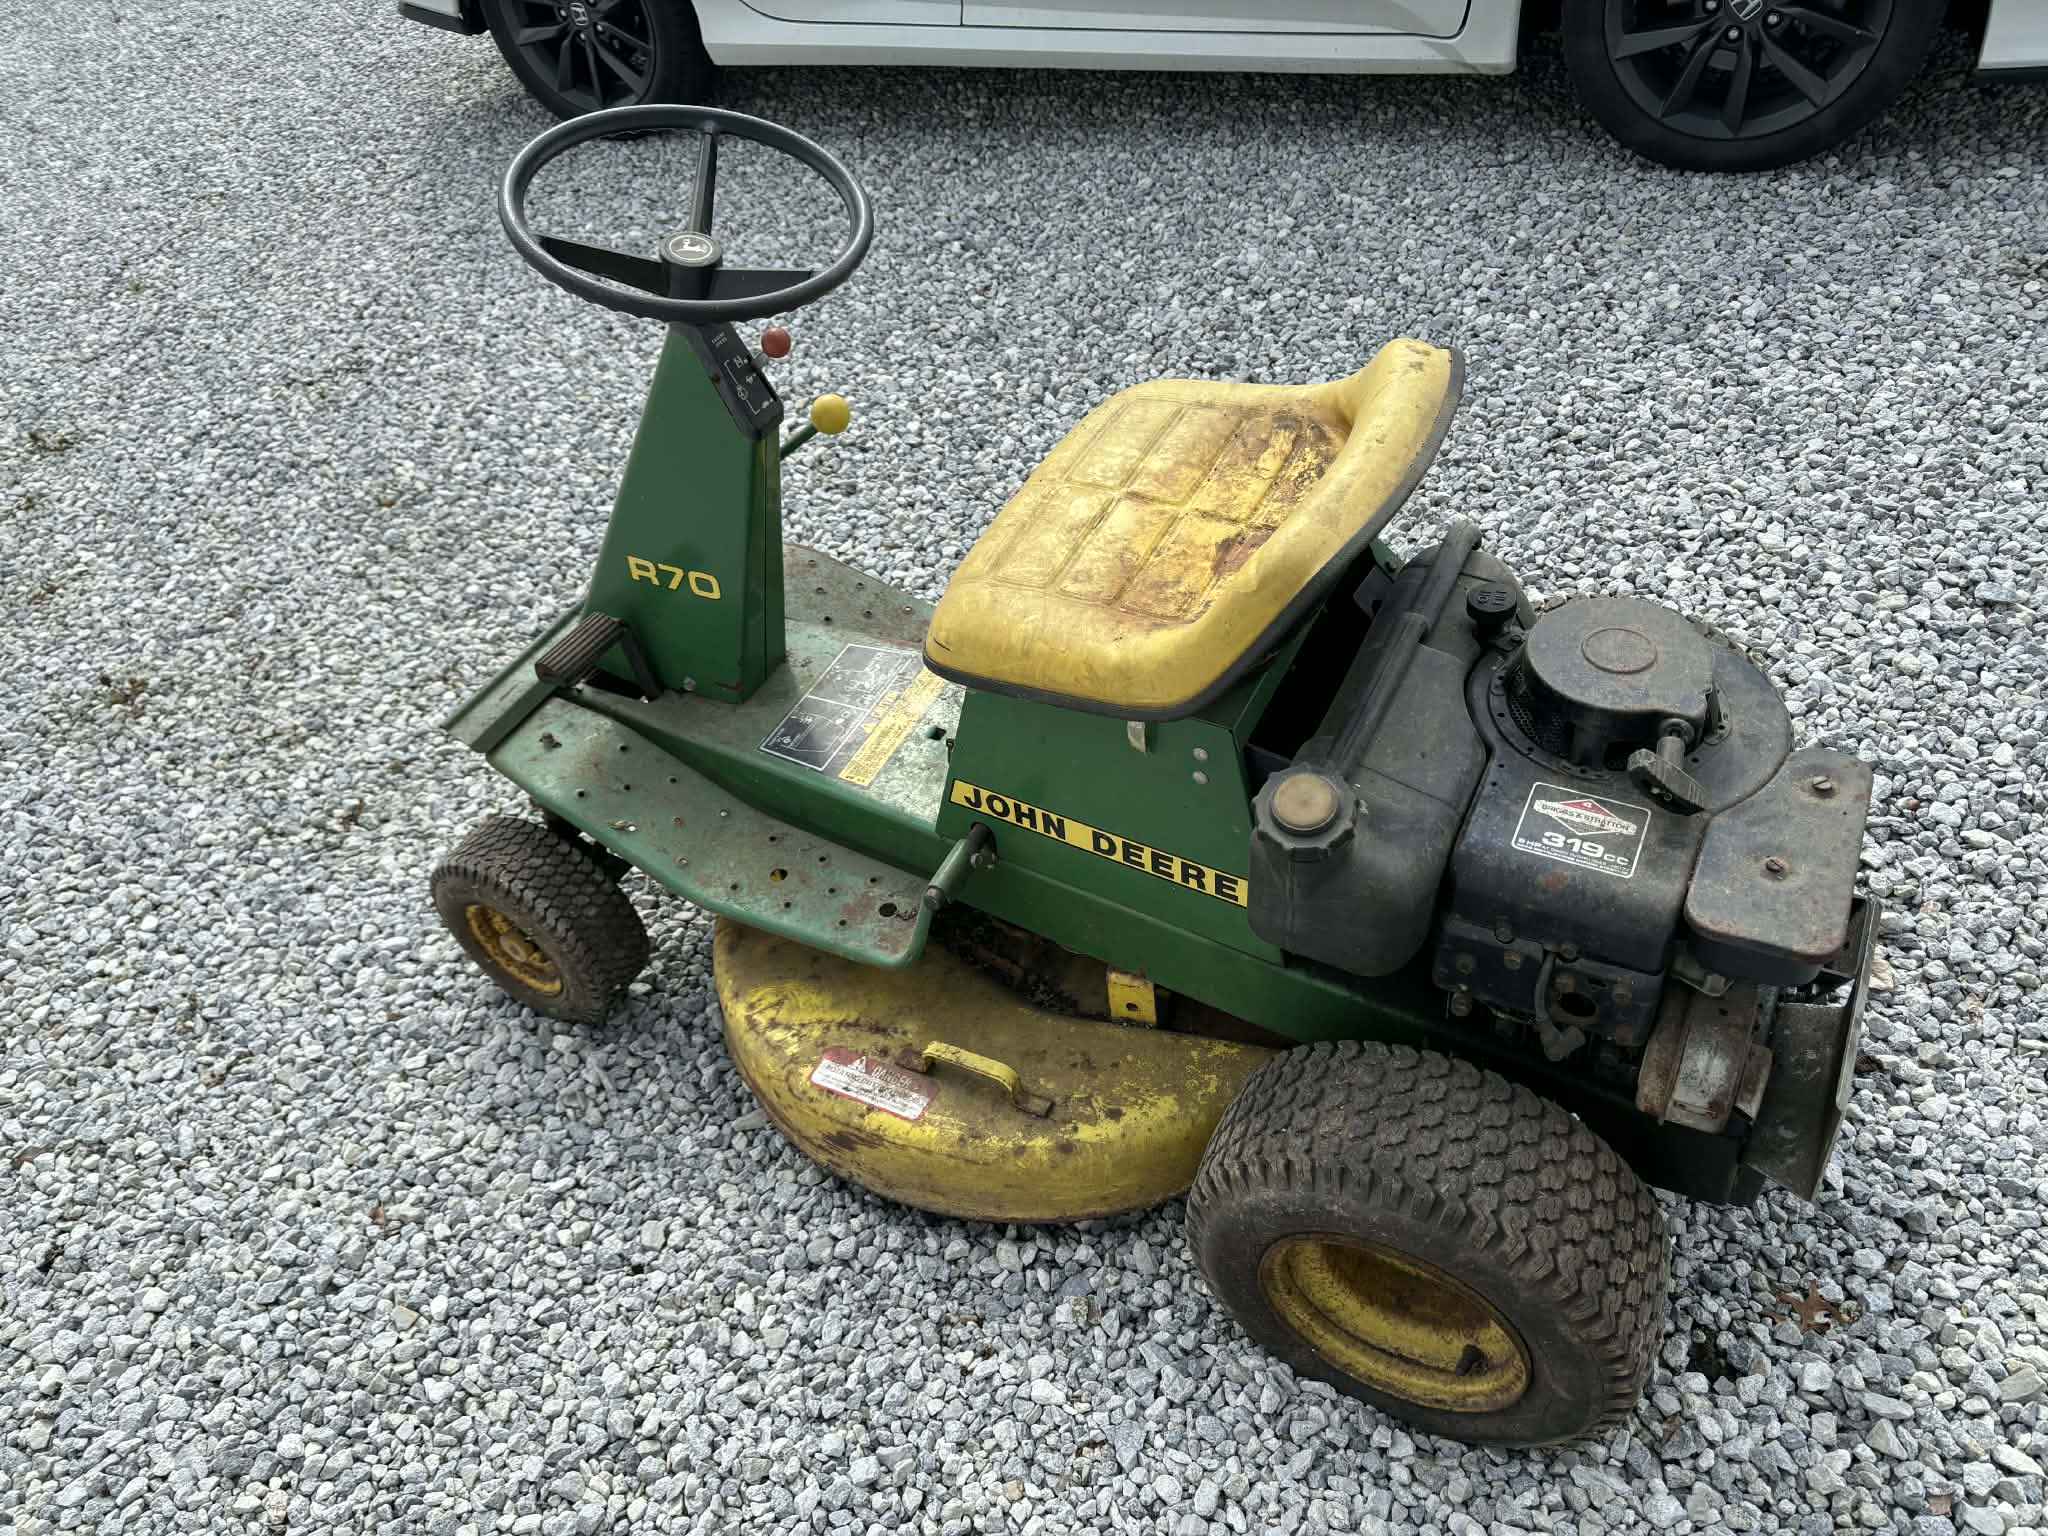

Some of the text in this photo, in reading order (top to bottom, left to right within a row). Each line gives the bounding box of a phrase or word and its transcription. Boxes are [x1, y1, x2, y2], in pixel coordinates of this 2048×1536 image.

[626, 554, 721, 600] R70
[963, 787, 1239, 902] JOHN DEERE
